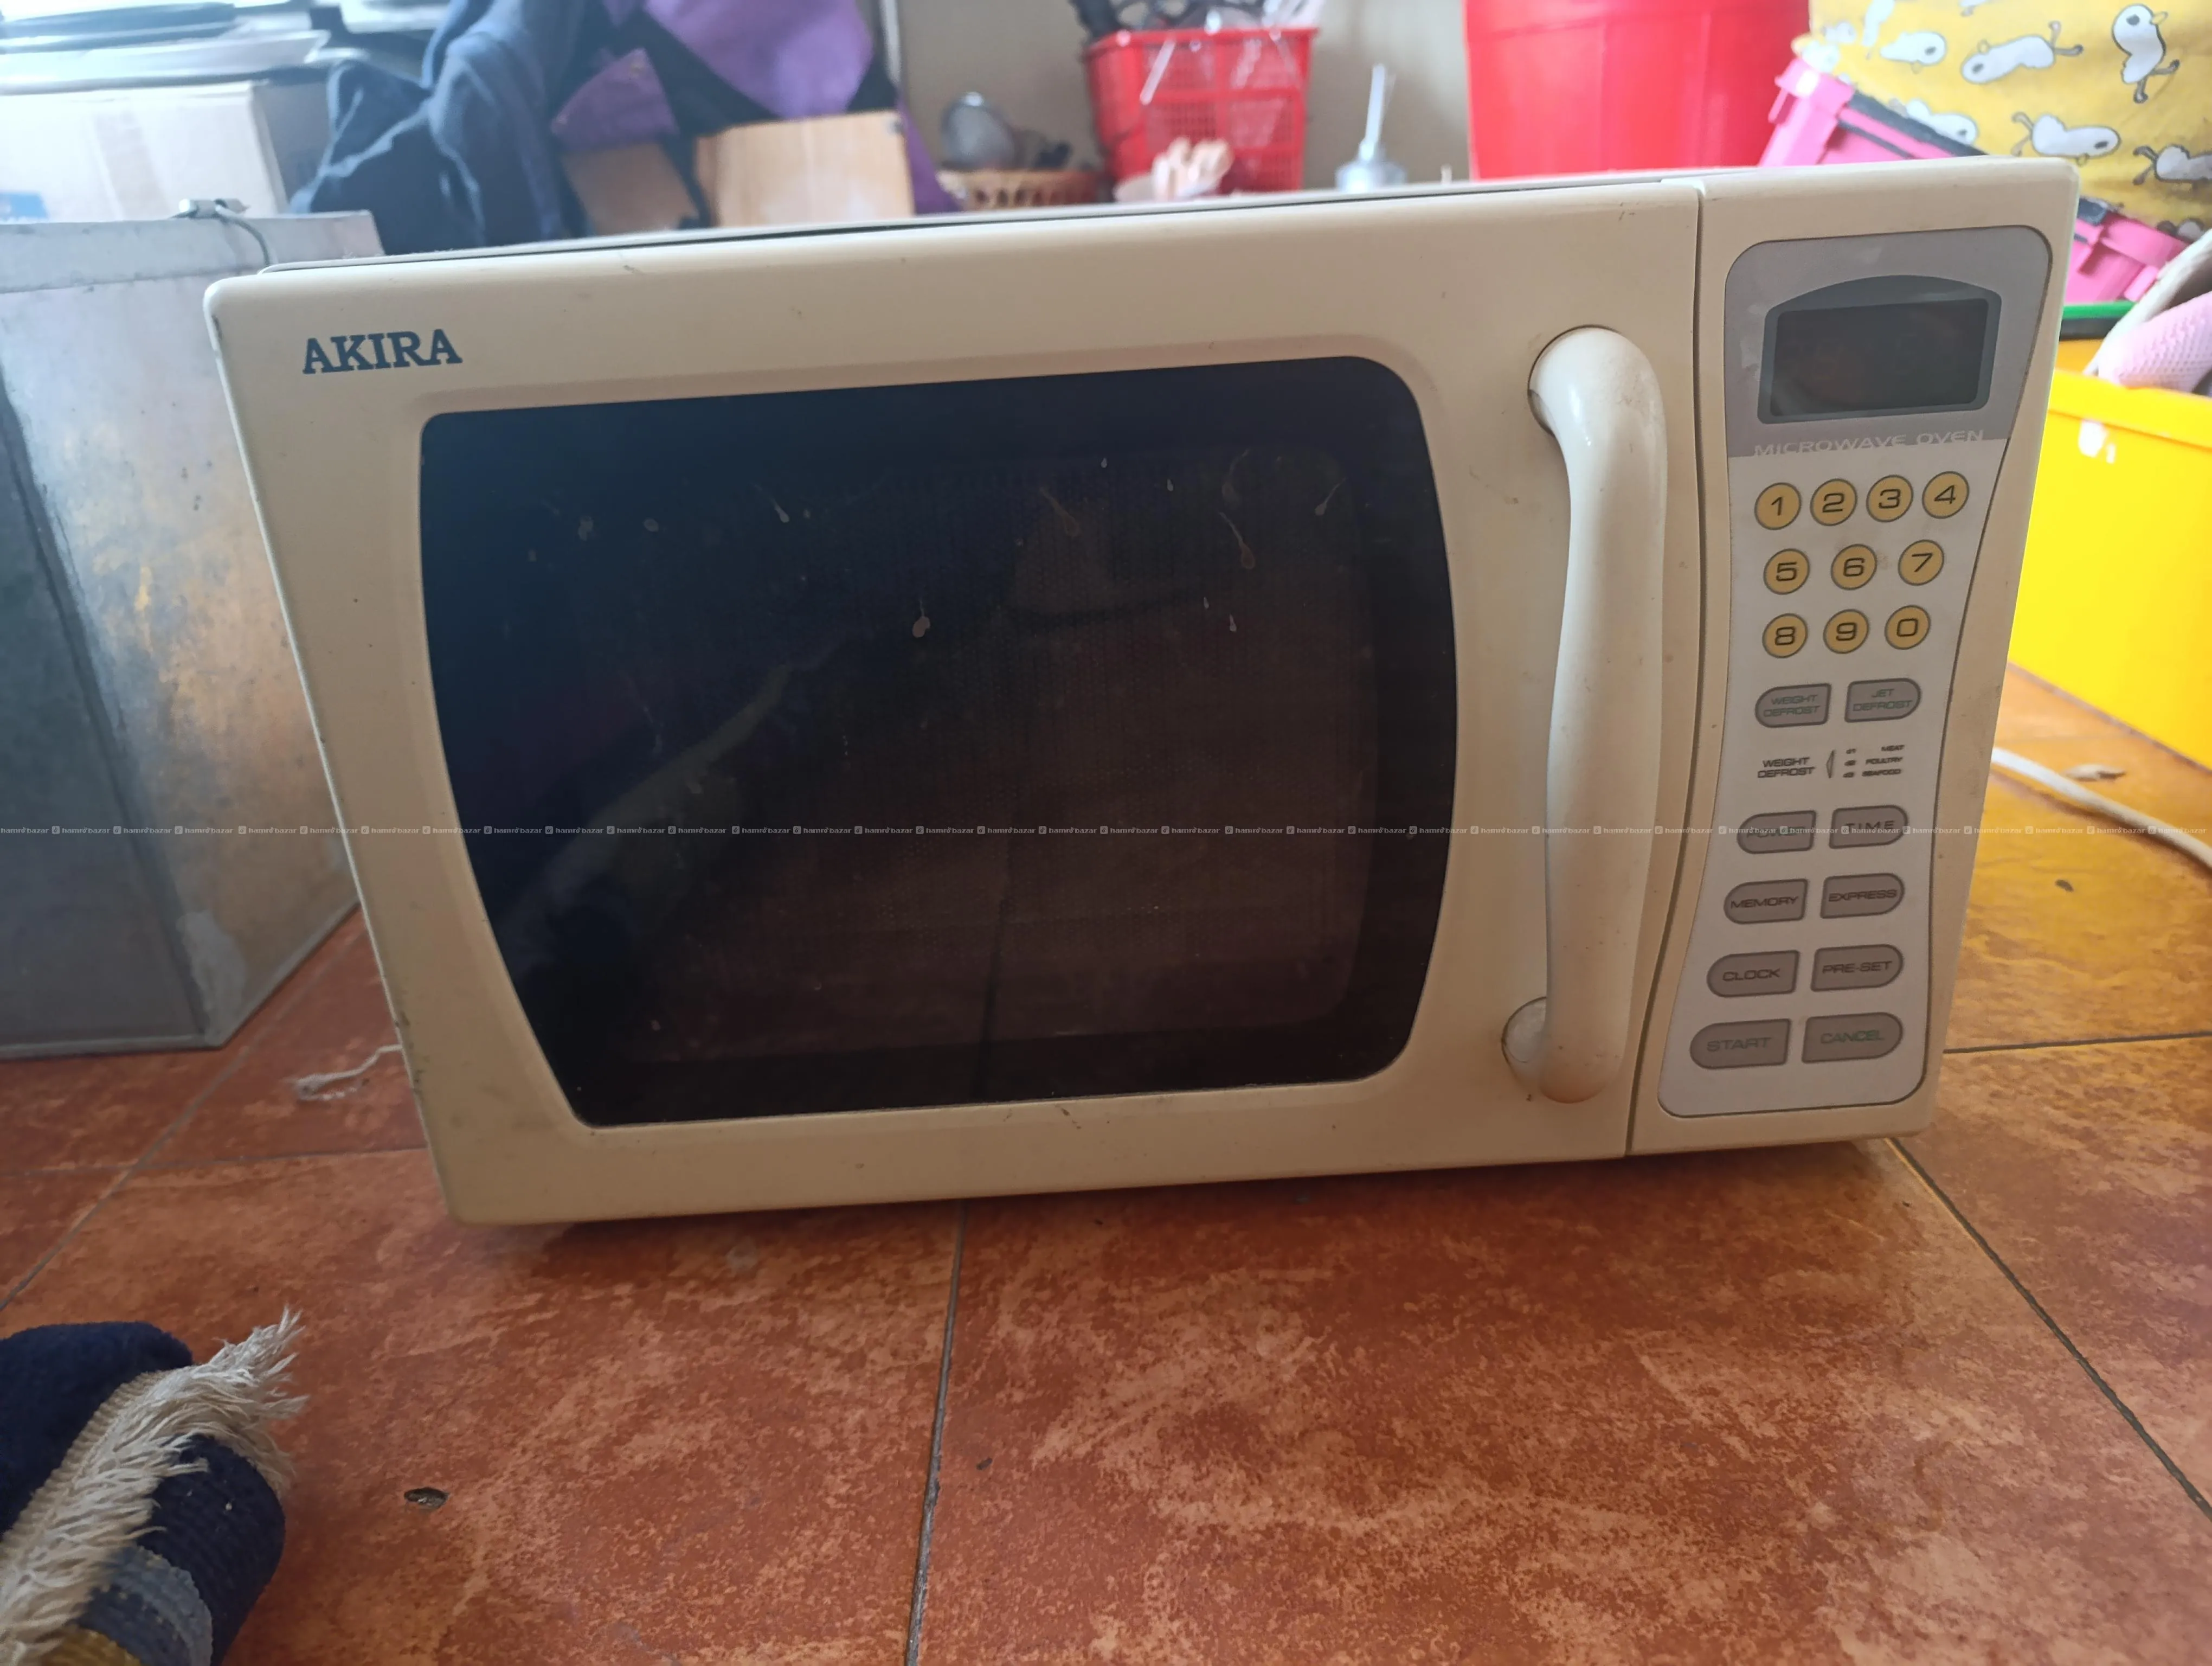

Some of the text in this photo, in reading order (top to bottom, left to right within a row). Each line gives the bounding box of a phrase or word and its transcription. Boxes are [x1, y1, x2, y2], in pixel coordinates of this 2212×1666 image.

[303, 329, 463, 374] AKIRA
[1754, 430, 1984, 456] MICROWAVE OVEN
[1771, 485, 1956, 516] 1 2 3 4
[1776, 553, 1933, 581] 5 6 7
[1774, 618, 1918, 646] 8 9 0
[1770, 694, 1818, 705] WEIGHT
[1872, 688, 1895, 698] JET
[1764, 706, 1821, 717] DEFROST
[1853, 700, 1913, 712] DEFROST
[1762, 757, 1811, 768] WEIGHT
[1866, 757, 1904, 765] POULTRY
[1757, 766, 1816, 779] DEFROST
[1862, 769, 1902, 777] SEAFOOD
[1844, 820, 1895, 832] TIME
[1828, 889, 1898, 902] EXPRESS
[1731, 896, 1799, 909] MEMORY
[1822, 961, 1893, 974] PRE-SET
[1722, 969, 1780, 982] CLOCK
[1820, 1030, 1885, 1045] CANCEL
[1707, 1037, 1772, 1052] START
